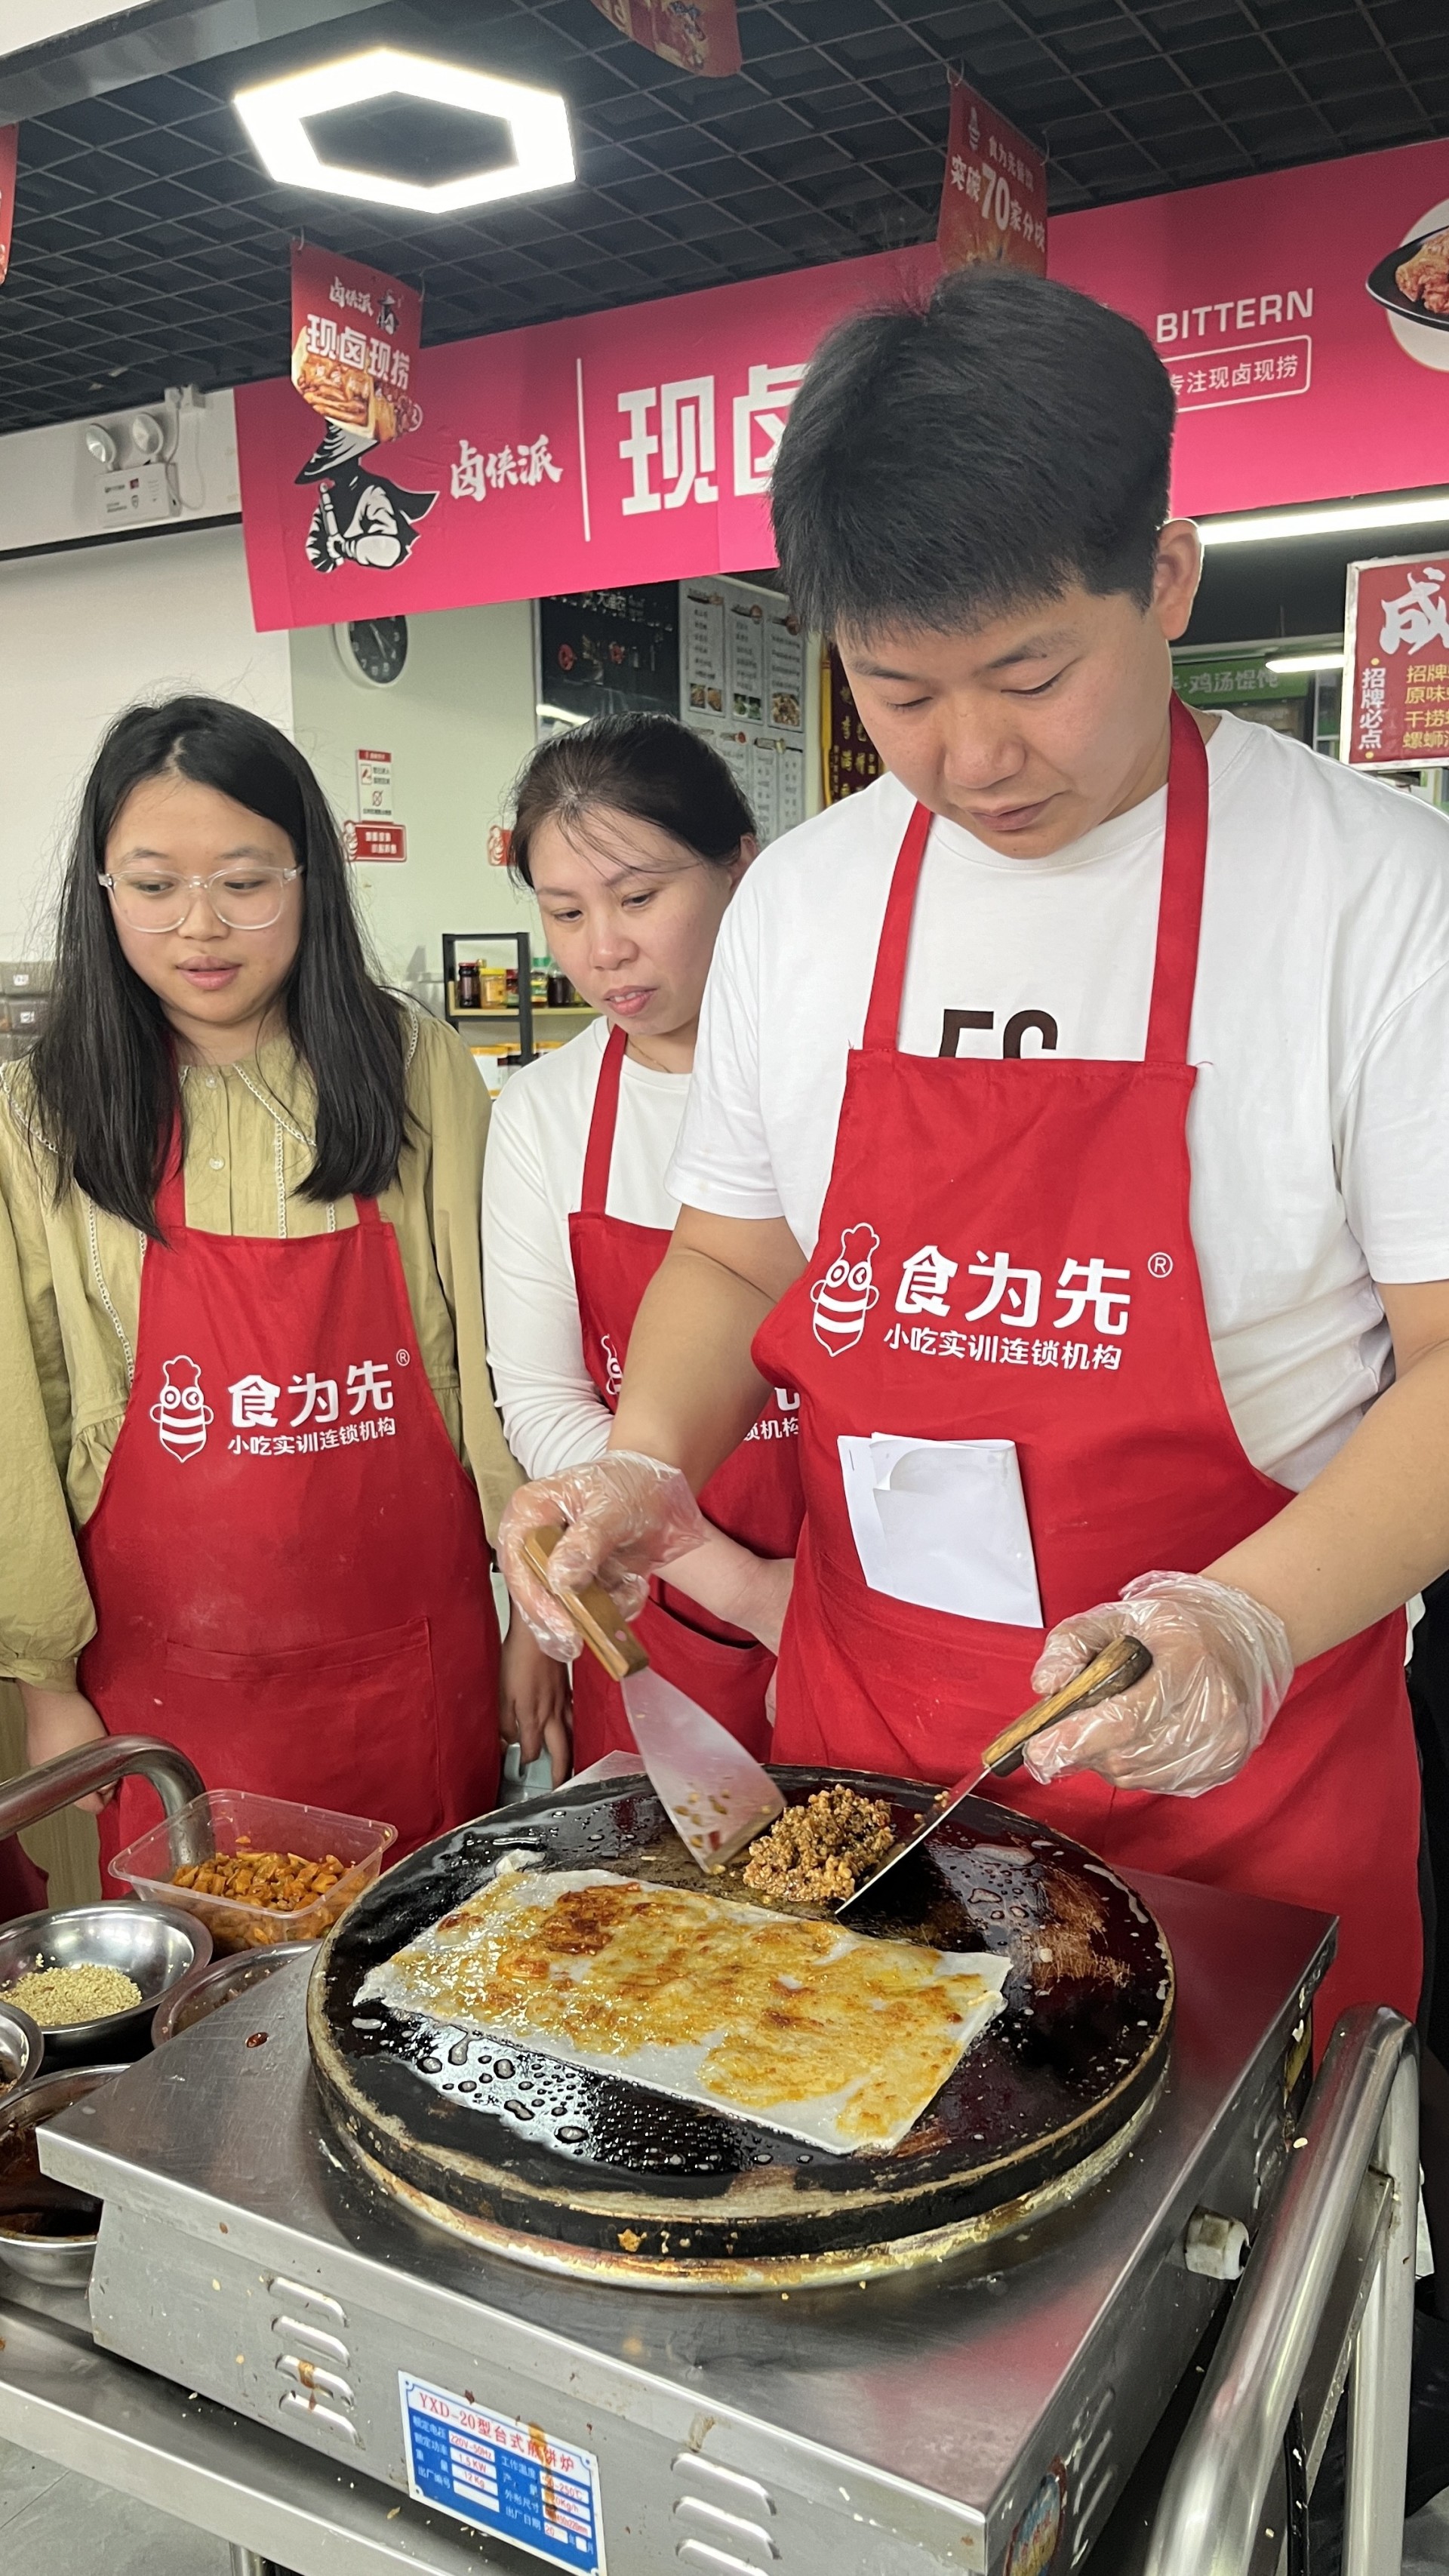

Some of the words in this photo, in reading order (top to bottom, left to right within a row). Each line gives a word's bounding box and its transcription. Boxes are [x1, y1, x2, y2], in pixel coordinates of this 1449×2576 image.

[1157, 288, 1313, 343] BITTERN
[306, 313, 411, 390] 现卤现捞
[1169, 354, 1299, 396] 专注现卤现捞
[451, 434, 565, 502] 卤侠派
[1404, 685, 1449, 704] 原味
[1406, 664, 1449, 684] 招牌
[1358, 667, 1387, 750] 招牌必点
[1404, 709, 1449, 728] 干捞
[894, 1245, 1131, 1335] 食为先
[884, 1322, 1122, 1371] 小吃实训连锁机构
[227, 1360, 395, 1428] 食为先
[227, 1417, 396, 1457] 小吃实训连锁机构
